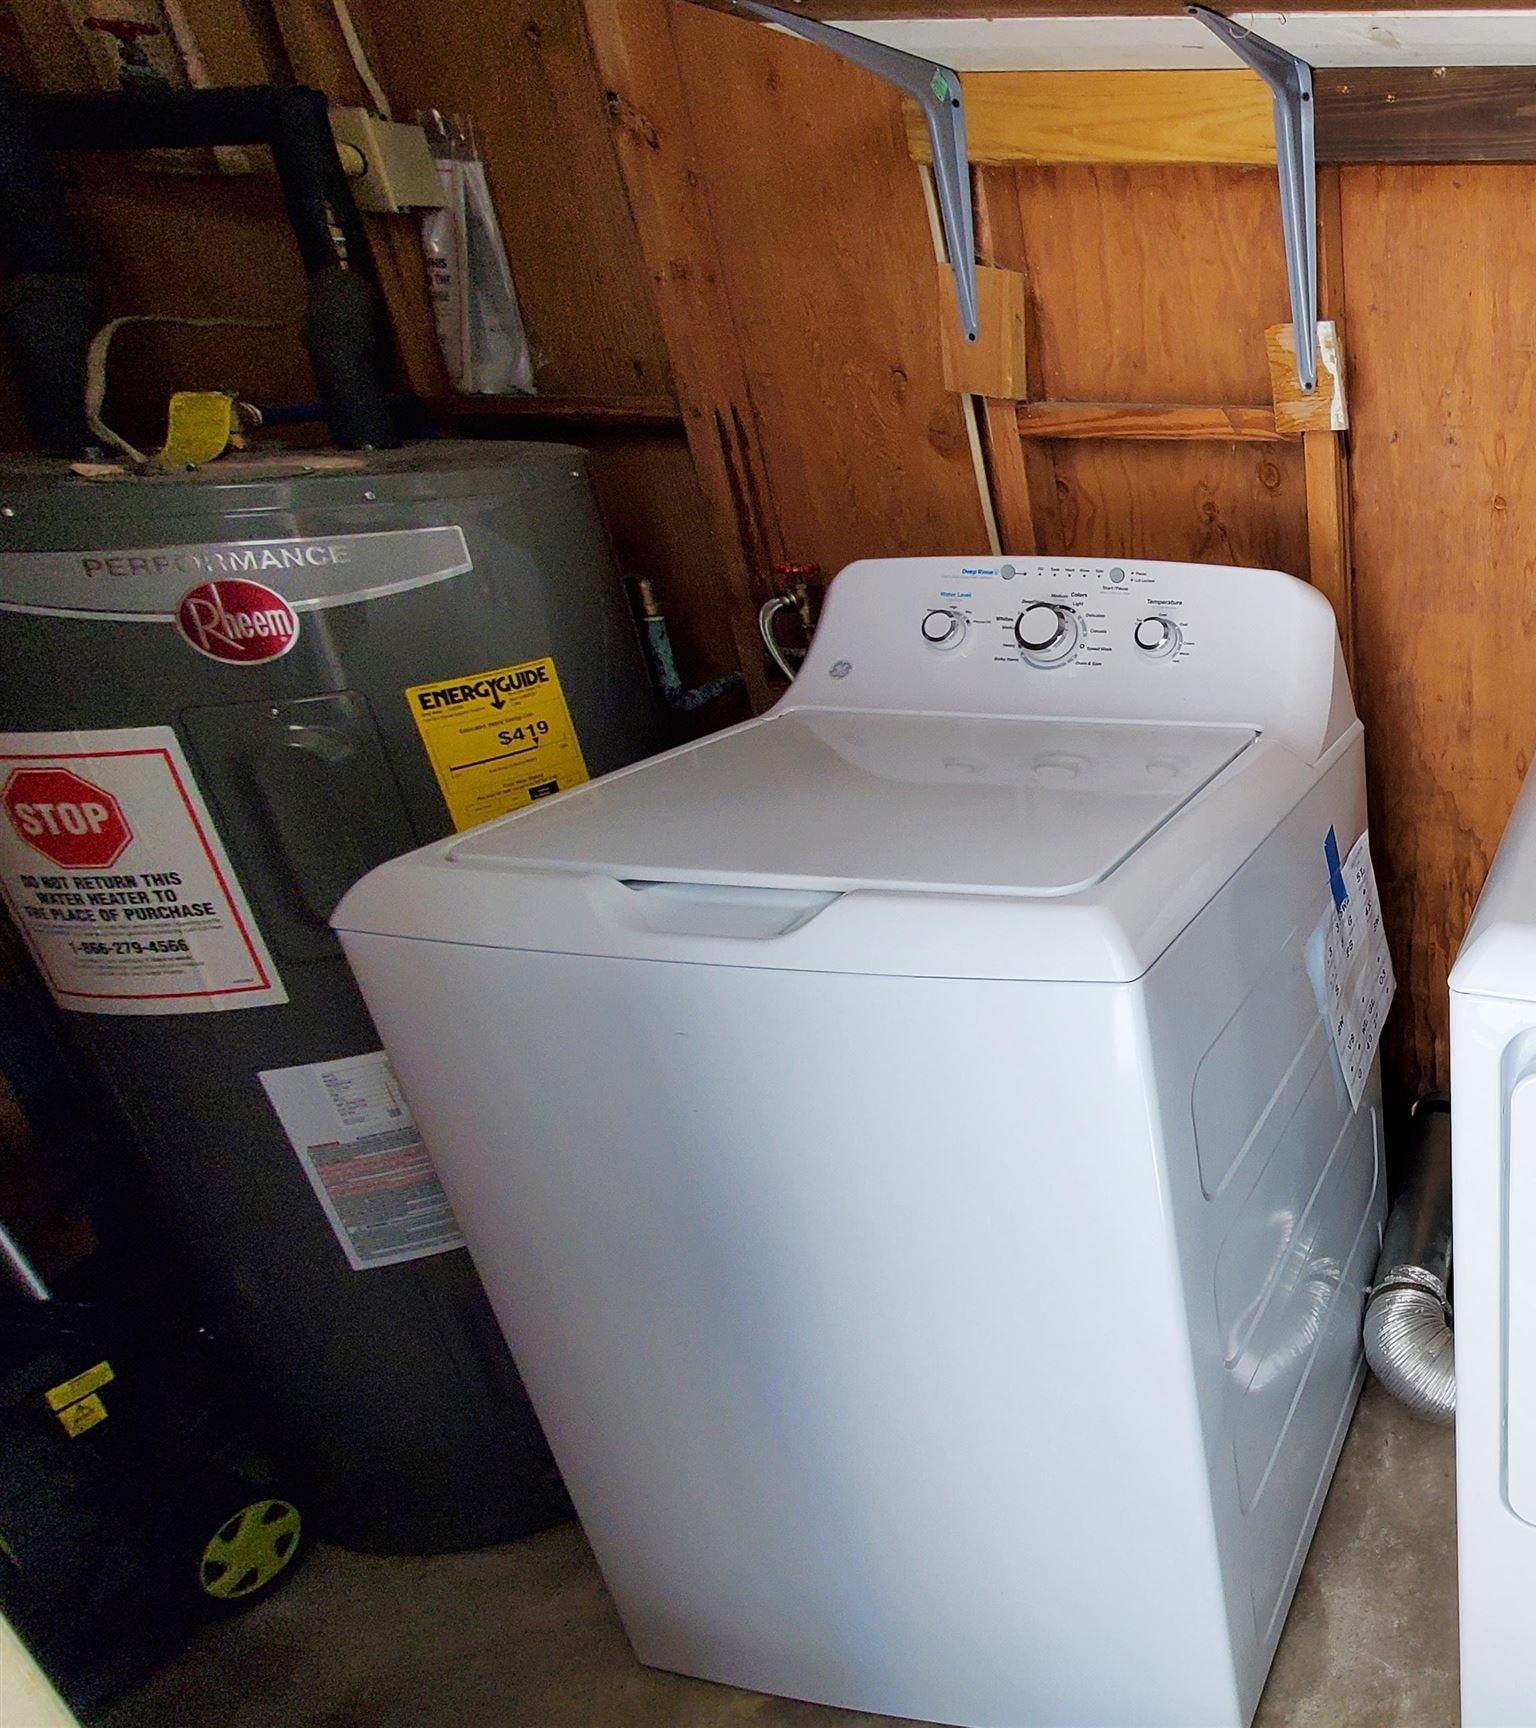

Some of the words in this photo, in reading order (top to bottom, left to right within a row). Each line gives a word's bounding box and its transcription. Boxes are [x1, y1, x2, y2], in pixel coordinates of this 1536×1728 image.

[181, 583, 294, 651] Rheem
[418, 666, 549, 711] ENERGYGUIDE
[498, 720, 549, 746] $419
[15, 802, 109, 835] STOP
[41, 875, 68, 890] NOT
[73, 875, 137, 890] RETURN
[141, 872, 182, 888] THIS
[36, 890, 86, 906] WATER
[88, 890, 150, 906] HEATER
[152, 889, 178, 903] TO
[50, 905, 96, 922] PLACE
[99, 906, 119, 922] OF
[124, 902, 216, 922] PURCHASE
